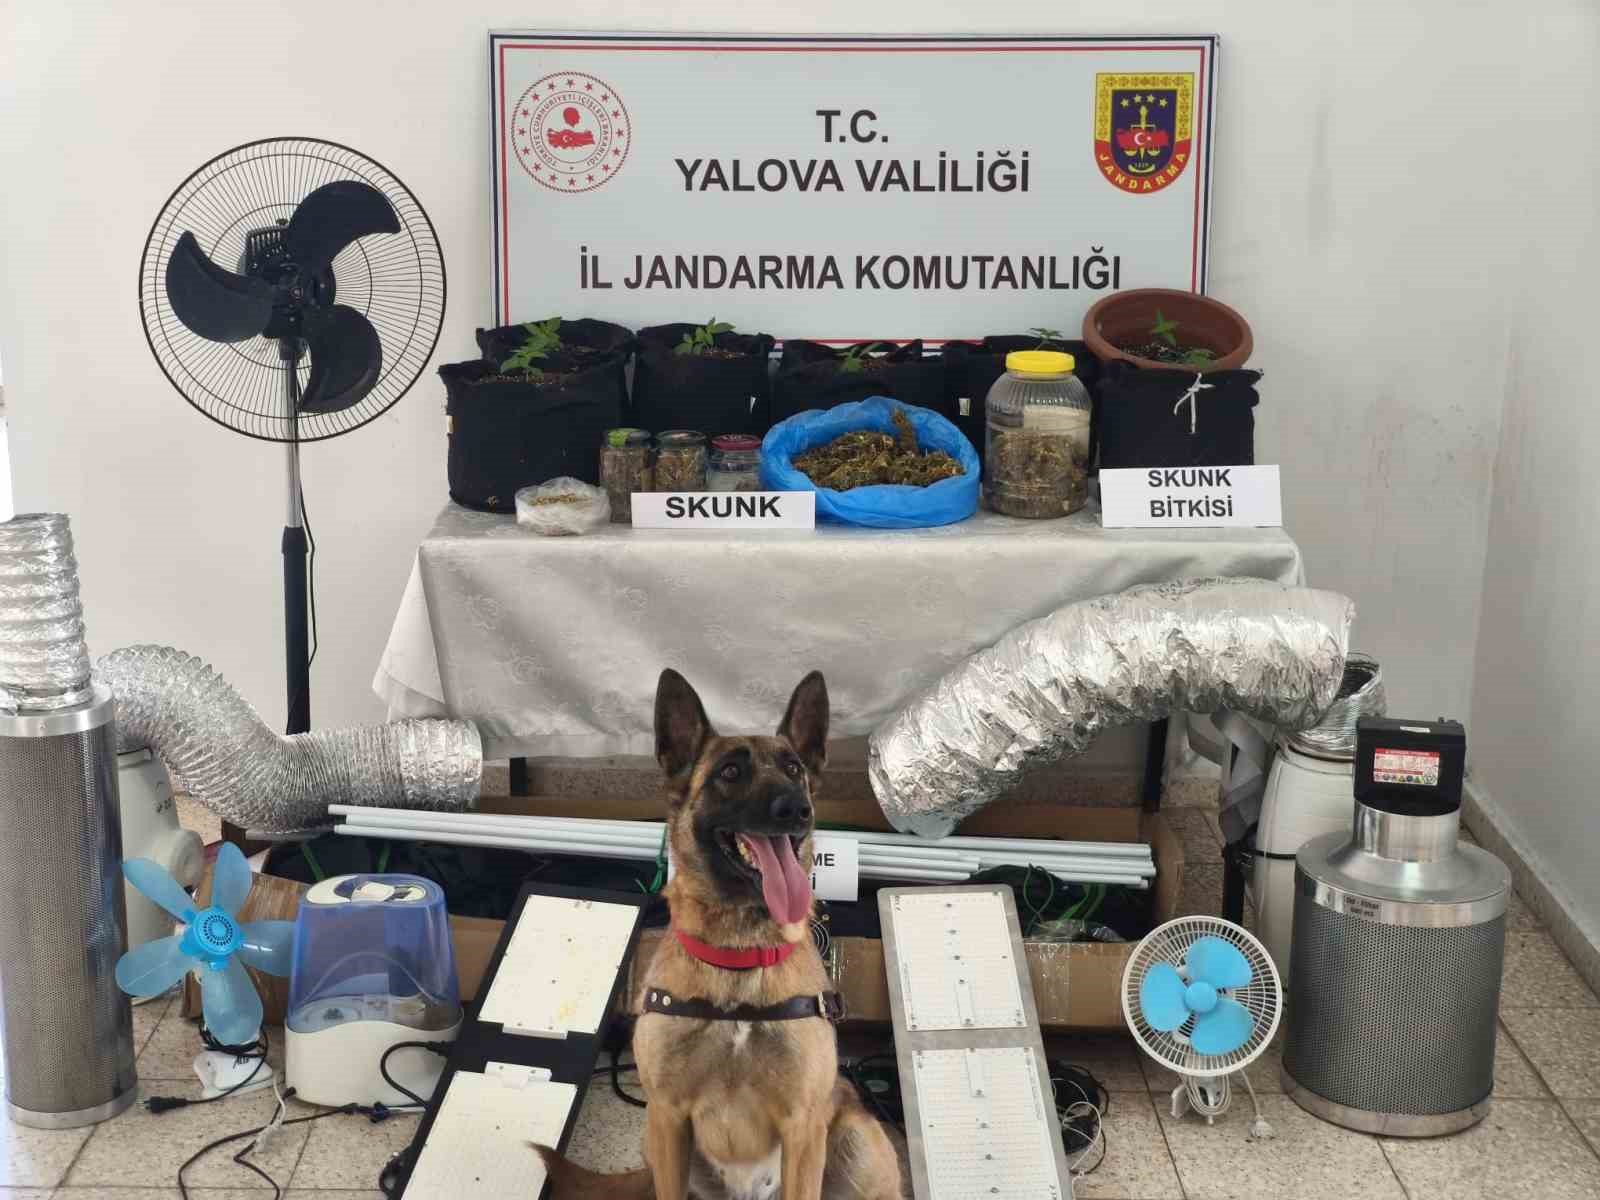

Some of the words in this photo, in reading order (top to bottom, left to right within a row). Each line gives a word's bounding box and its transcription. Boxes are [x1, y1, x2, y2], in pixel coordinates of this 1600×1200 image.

[816, 110, 889, 143] T.C.
[676, 159, 844, 192] YALOVA
[856, 151, 1030, 192] VALİLİĞİ
[1100, 154, 1186, 190] JANDARMA
[581, 246, 613, 289] İL
[624, 255, 844, 290] JANDARMA
[855, 246, 1121, 290] KOMUTANLIĞI
[1148, 469, 1232, 488] SKUNK
[665, 496, 781, 518] SKUNK
[1150, 495, 1233, 518] BİTKİSİ
